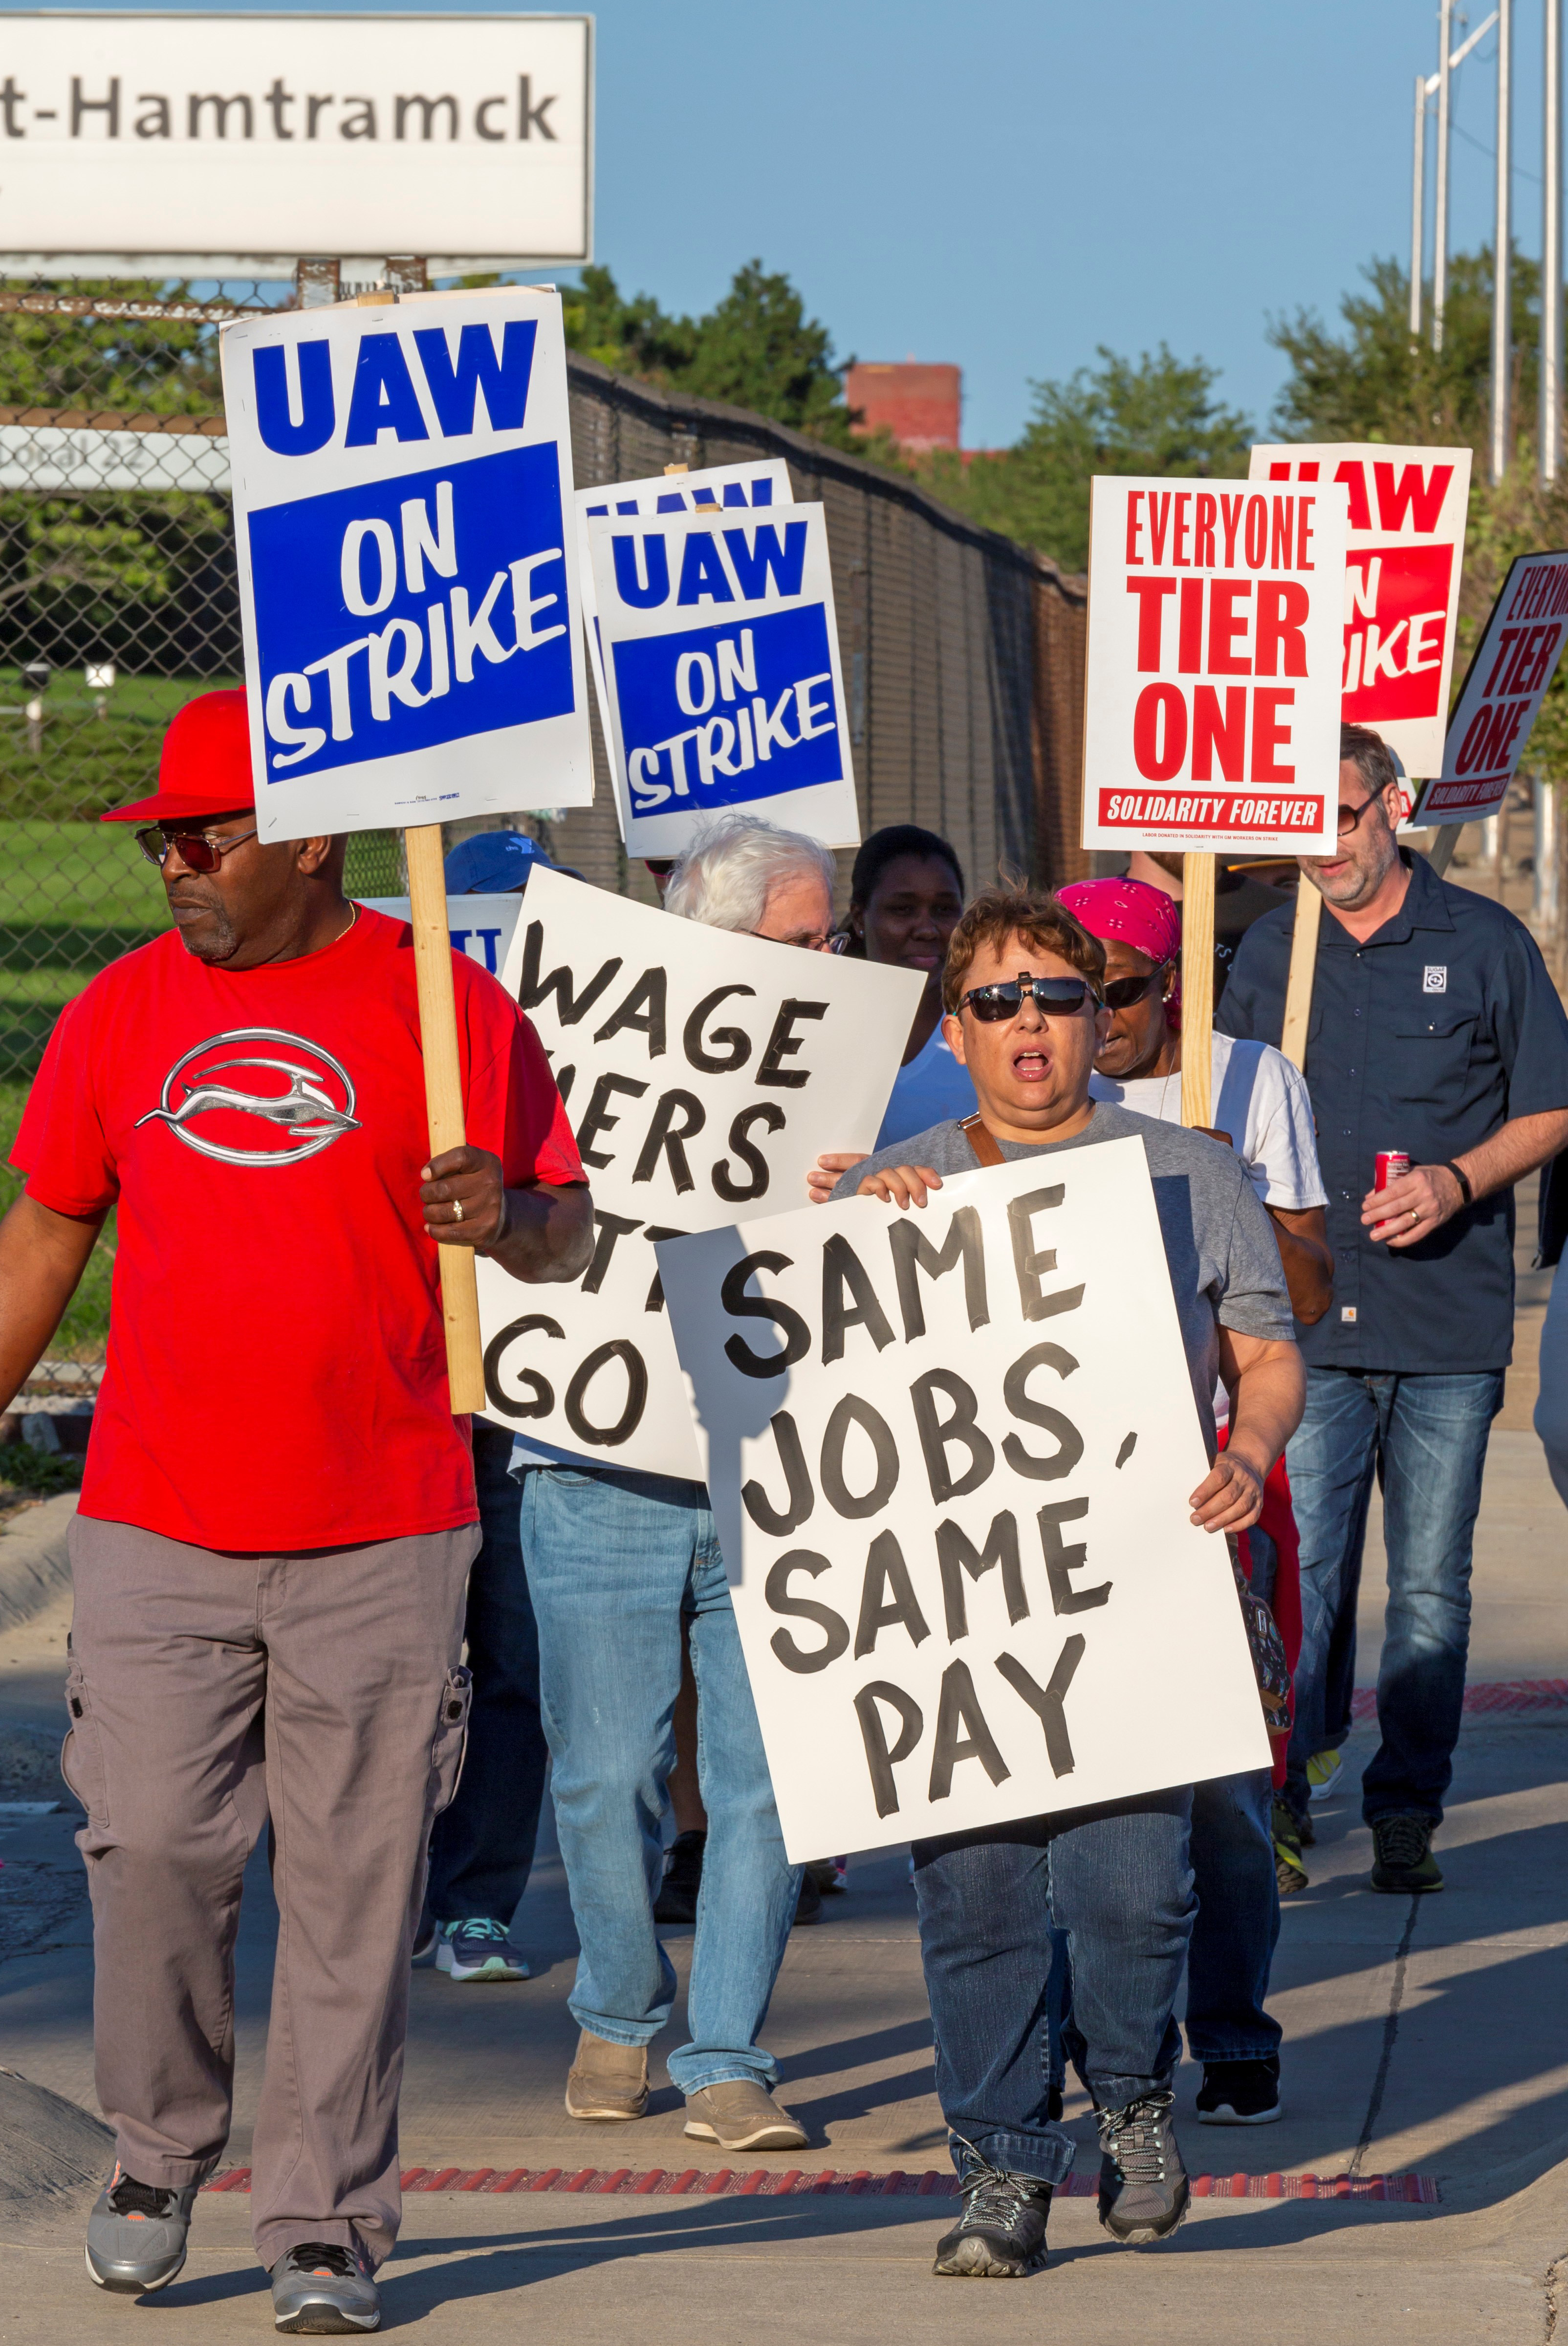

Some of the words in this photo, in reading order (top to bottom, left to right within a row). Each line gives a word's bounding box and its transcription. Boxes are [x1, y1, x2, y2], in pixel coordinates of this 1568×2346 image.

[253, 320, 538, 456] UAW
[0, 434, 87, 468] ocal
[1268, 461, 1455, 533] AW
[341, 480, 458, 616] ON
[612, 521, 807, 608] UAW
[1126, 491, 1315, 570] EVERYONE
[1127, 576, 1309, 677] TIER
[1344, 557, 1382, 624] N
[265, 547, 566, 768] STRIKE
[675, 629, 758, 716] ON
[1342, 610, 1446, 694] IKE
[1482, 622, 1562, 698] TIER
[628, 673, 835, 809] STRIKE
[1133, 682, 1295, 783] ONE
[1455, 699, 1532, 775] ONE
[1107, 795, 1225, 823] SOLIDARITY
[1229, 799, 1318, 825] FOREVER
[519, 920, 829, 1088] WAGE
[720, 1183, 1086, 1380] SAME
[484, 1314, 648, 1447] GO
[740, 1342, 1138, 1537] JOBS,
[765, 1497, 1113, 1674] SAME
[853, 1633, 1086, 1819] PAY
